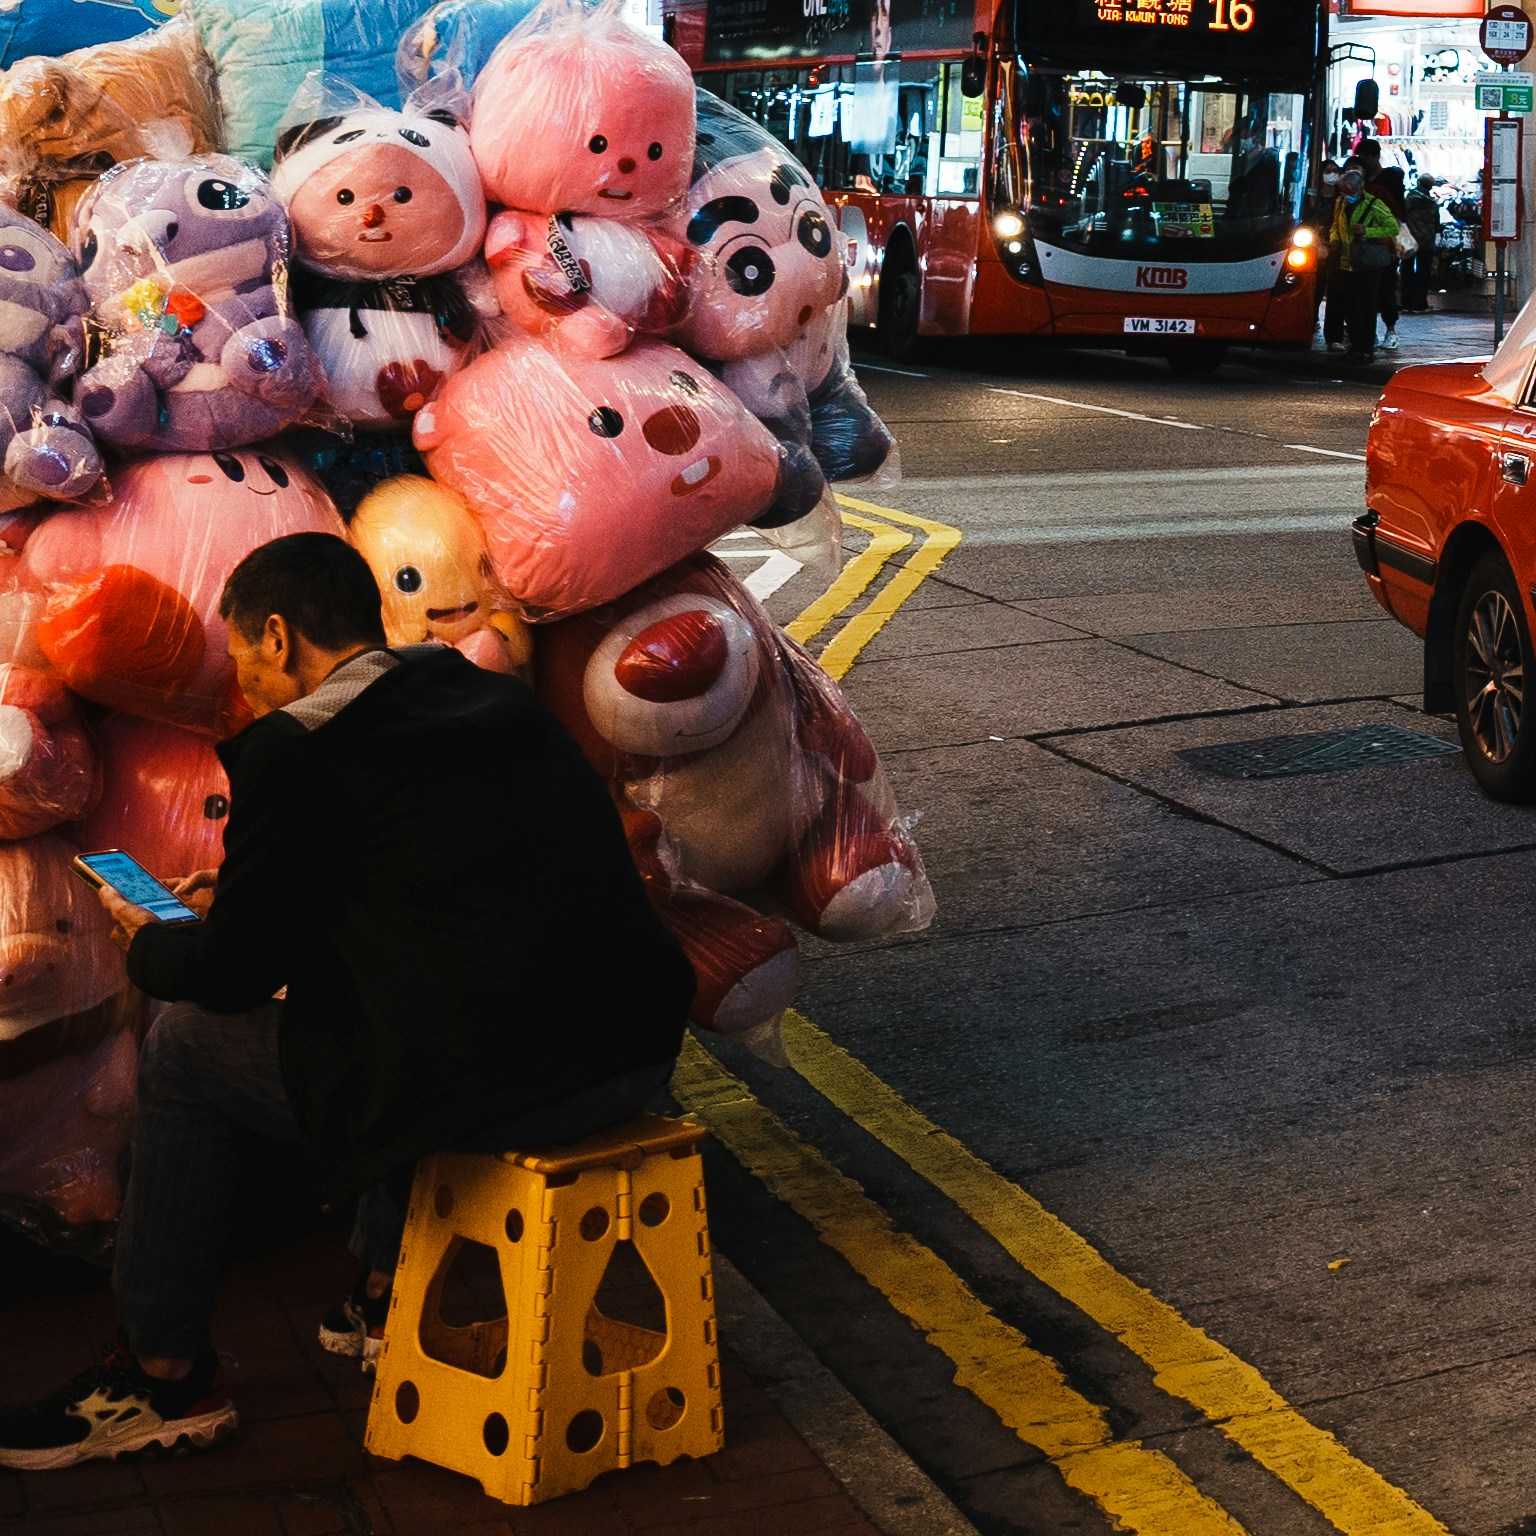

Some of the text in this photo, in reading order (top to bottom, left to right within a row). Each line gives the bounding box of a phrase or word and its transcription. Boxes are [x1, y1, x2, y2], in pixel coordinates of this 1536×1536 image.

[1097, 9, 1188, 26] VIA: KWUN TONG
[1136, 266, 1188, 290] KMB
[1131, 319, 1187, 333] VM 3142
